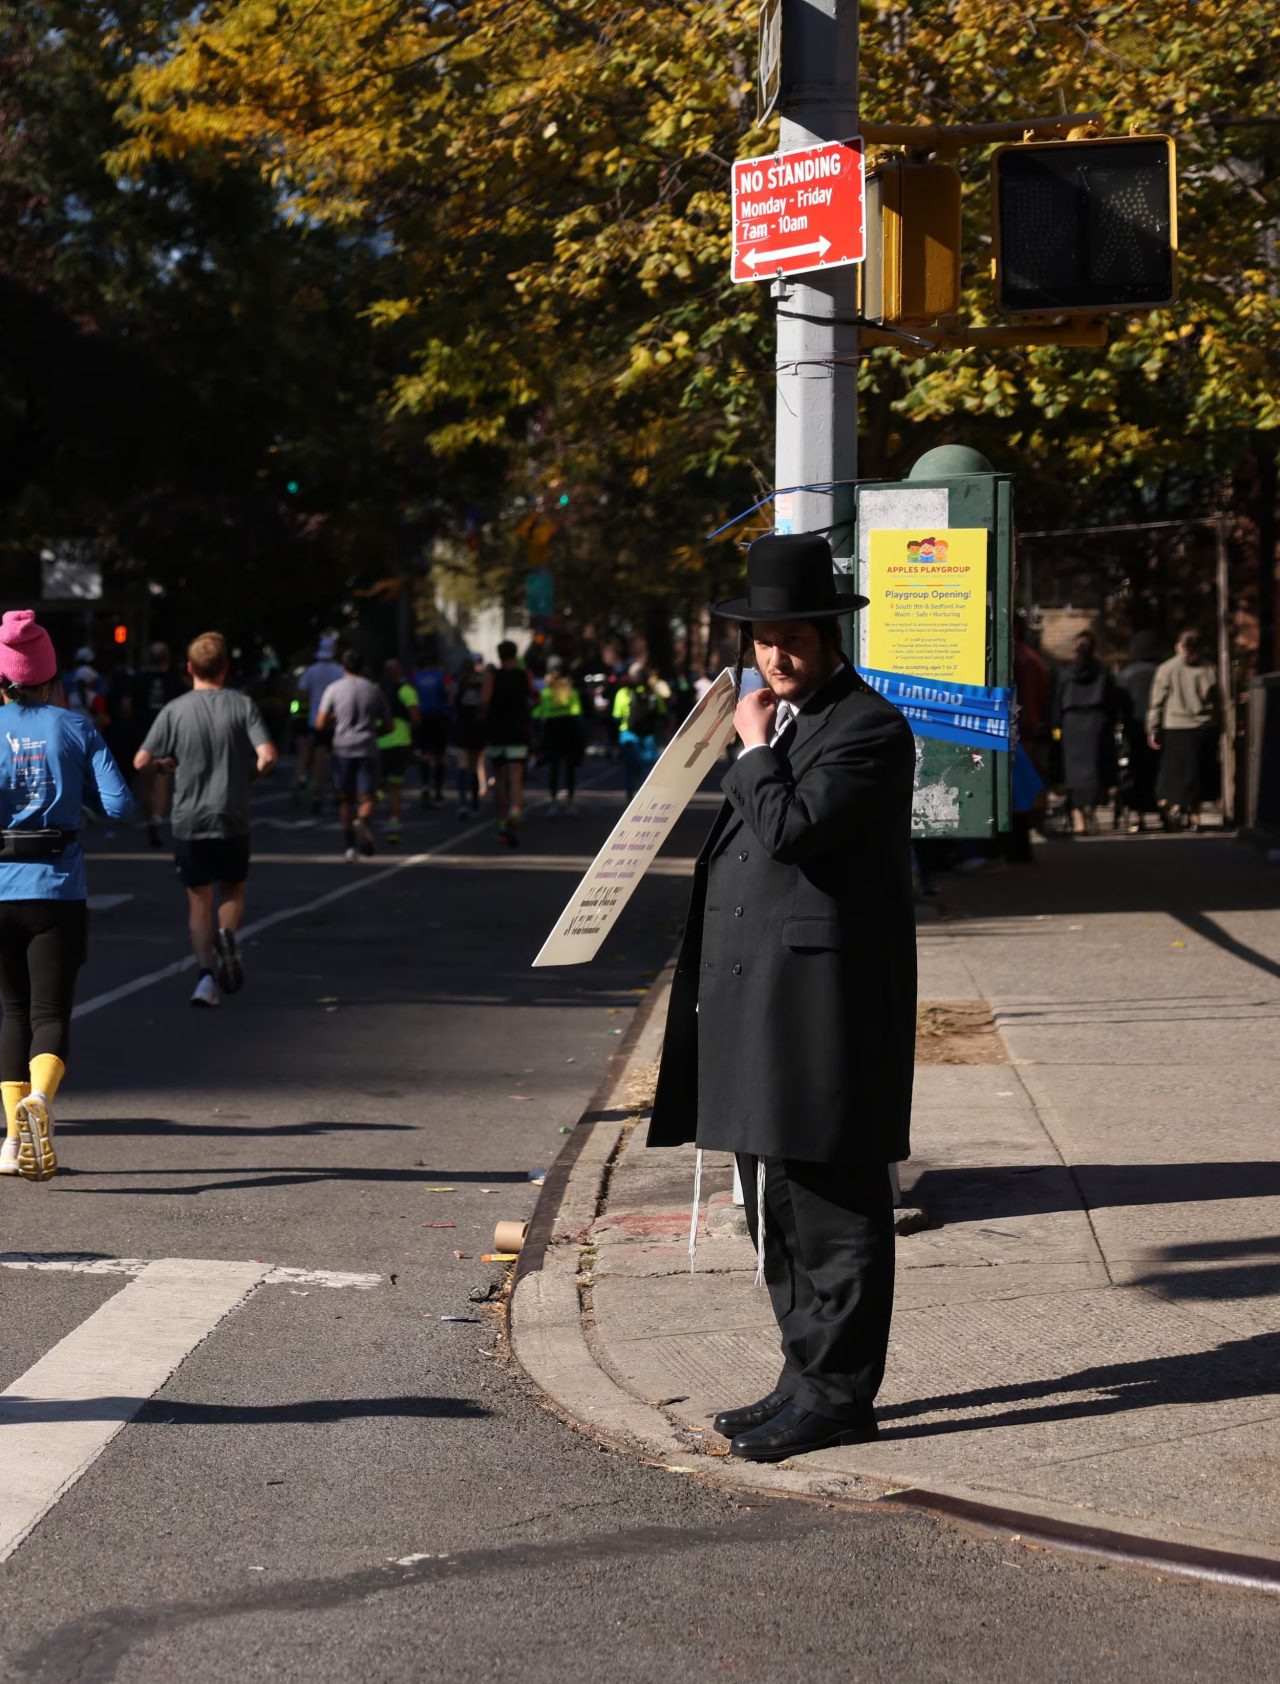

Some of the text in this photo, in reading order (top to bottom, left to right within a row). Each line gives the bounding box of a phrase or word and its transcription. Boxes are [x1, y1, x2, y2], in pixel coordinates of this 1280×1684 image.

[740, 153, 841, 194] NO STANDING
[741, 196, 787, 219] Monday
[797, 186, 833, 208] Friday
[742, 221, 768, 240] 7am
[778, 215, 808, 233] 10am
[885, 590, 972, 600] Playgroup Opening!
